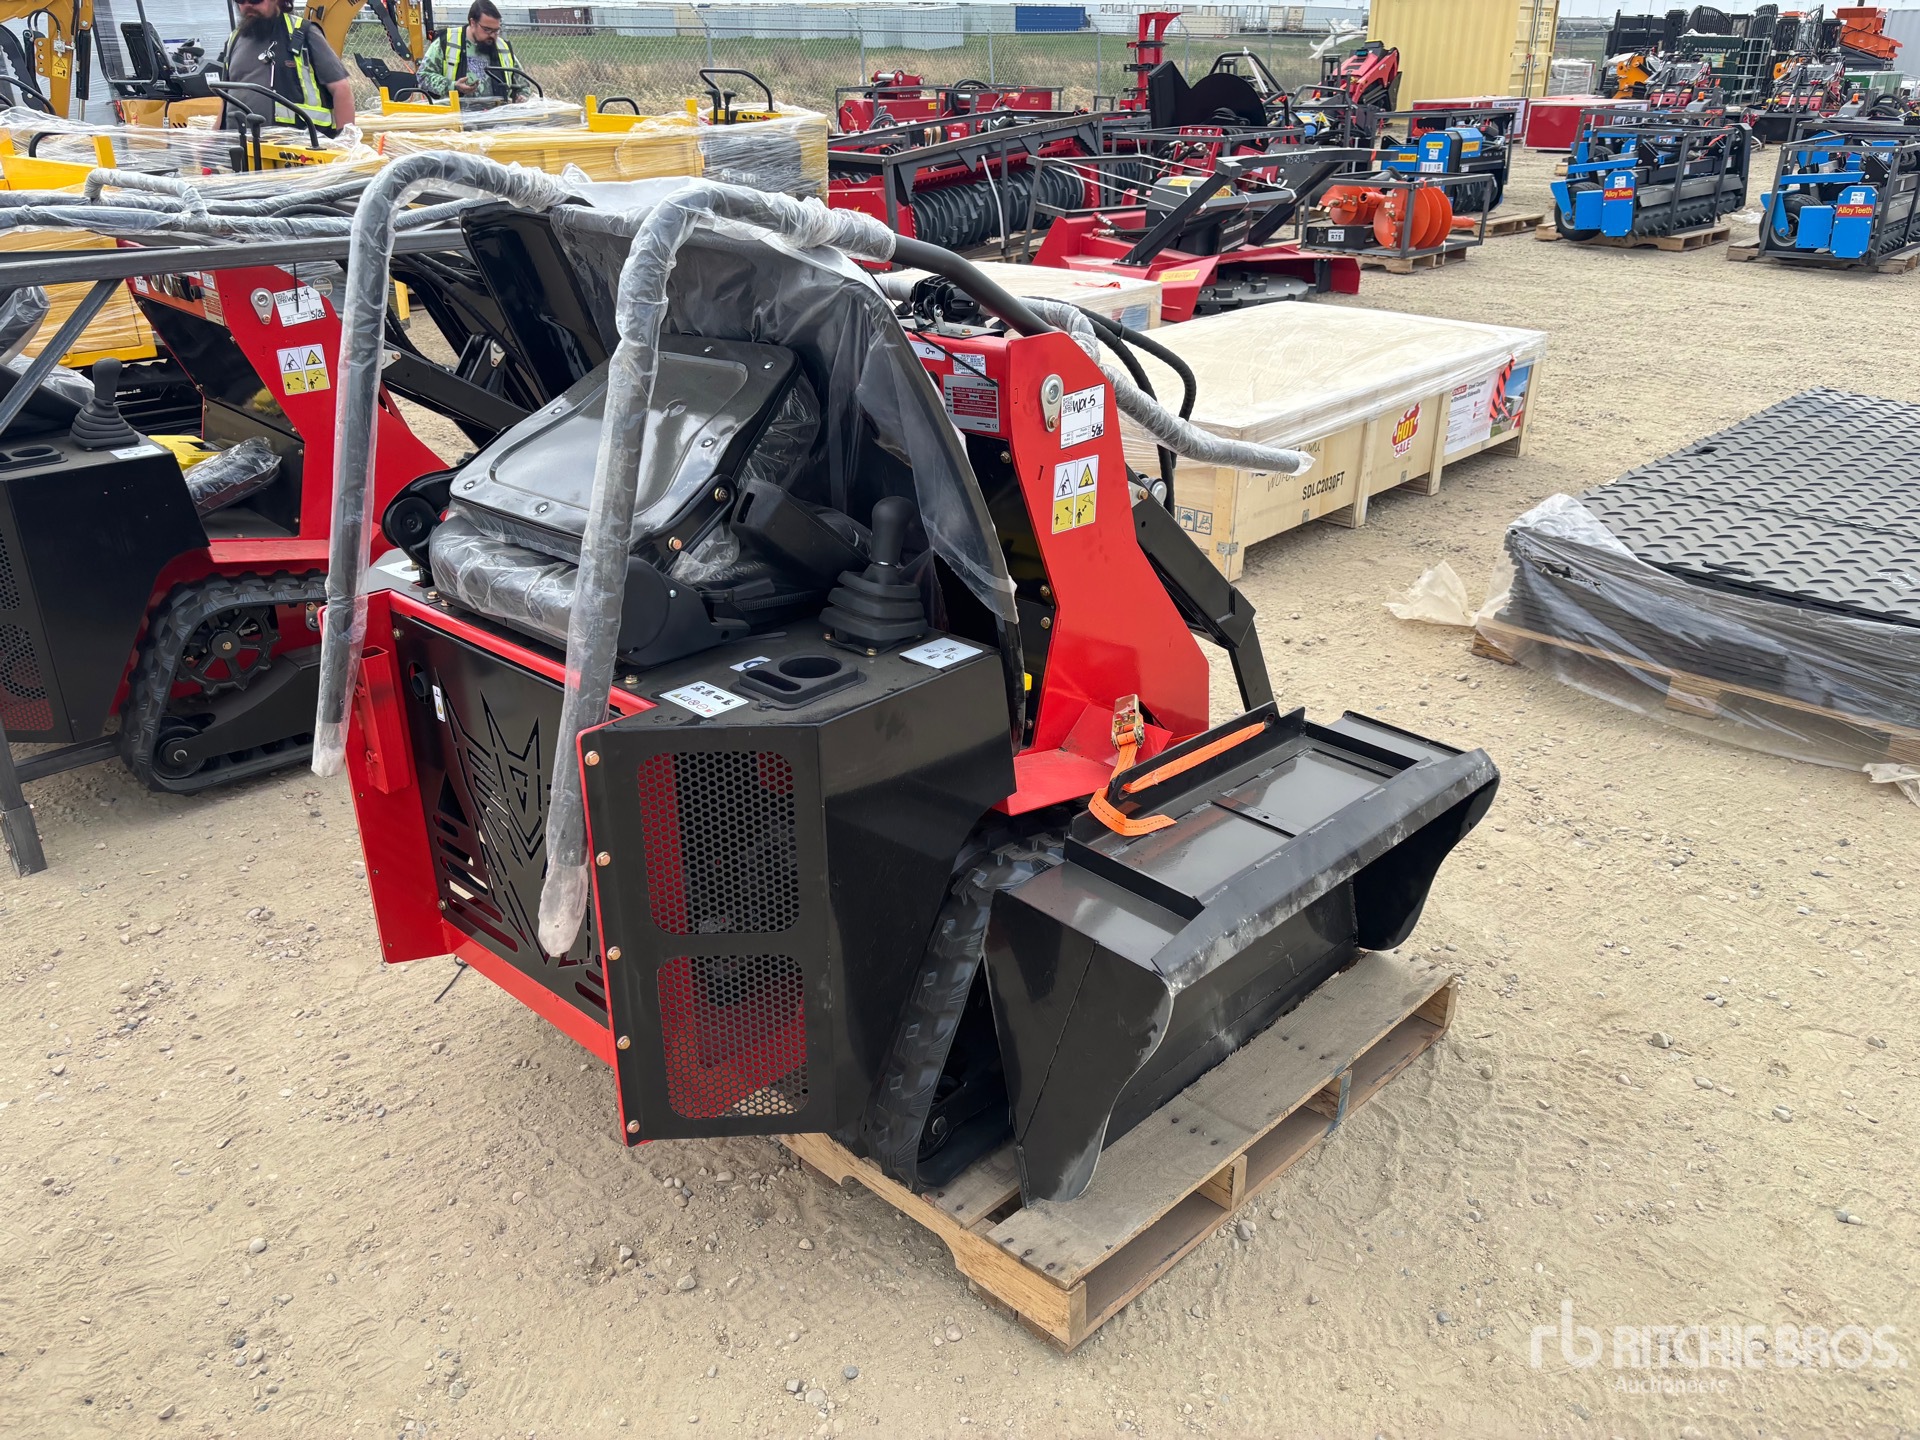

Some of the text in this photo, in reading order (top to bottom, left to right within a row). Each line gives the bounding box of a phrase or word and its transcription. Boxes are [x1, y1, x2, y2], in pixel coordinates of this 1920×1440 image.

[1604, 189, 1633, 198] Alloy Teeth
[1837, 206, 1873, 215] Alloy Teeth
[1395, 416, 1416, 443] HOT
[1395, 439, 1411, 457] SALE
[1302, 470, 1346, 501] SDLC2030FT
